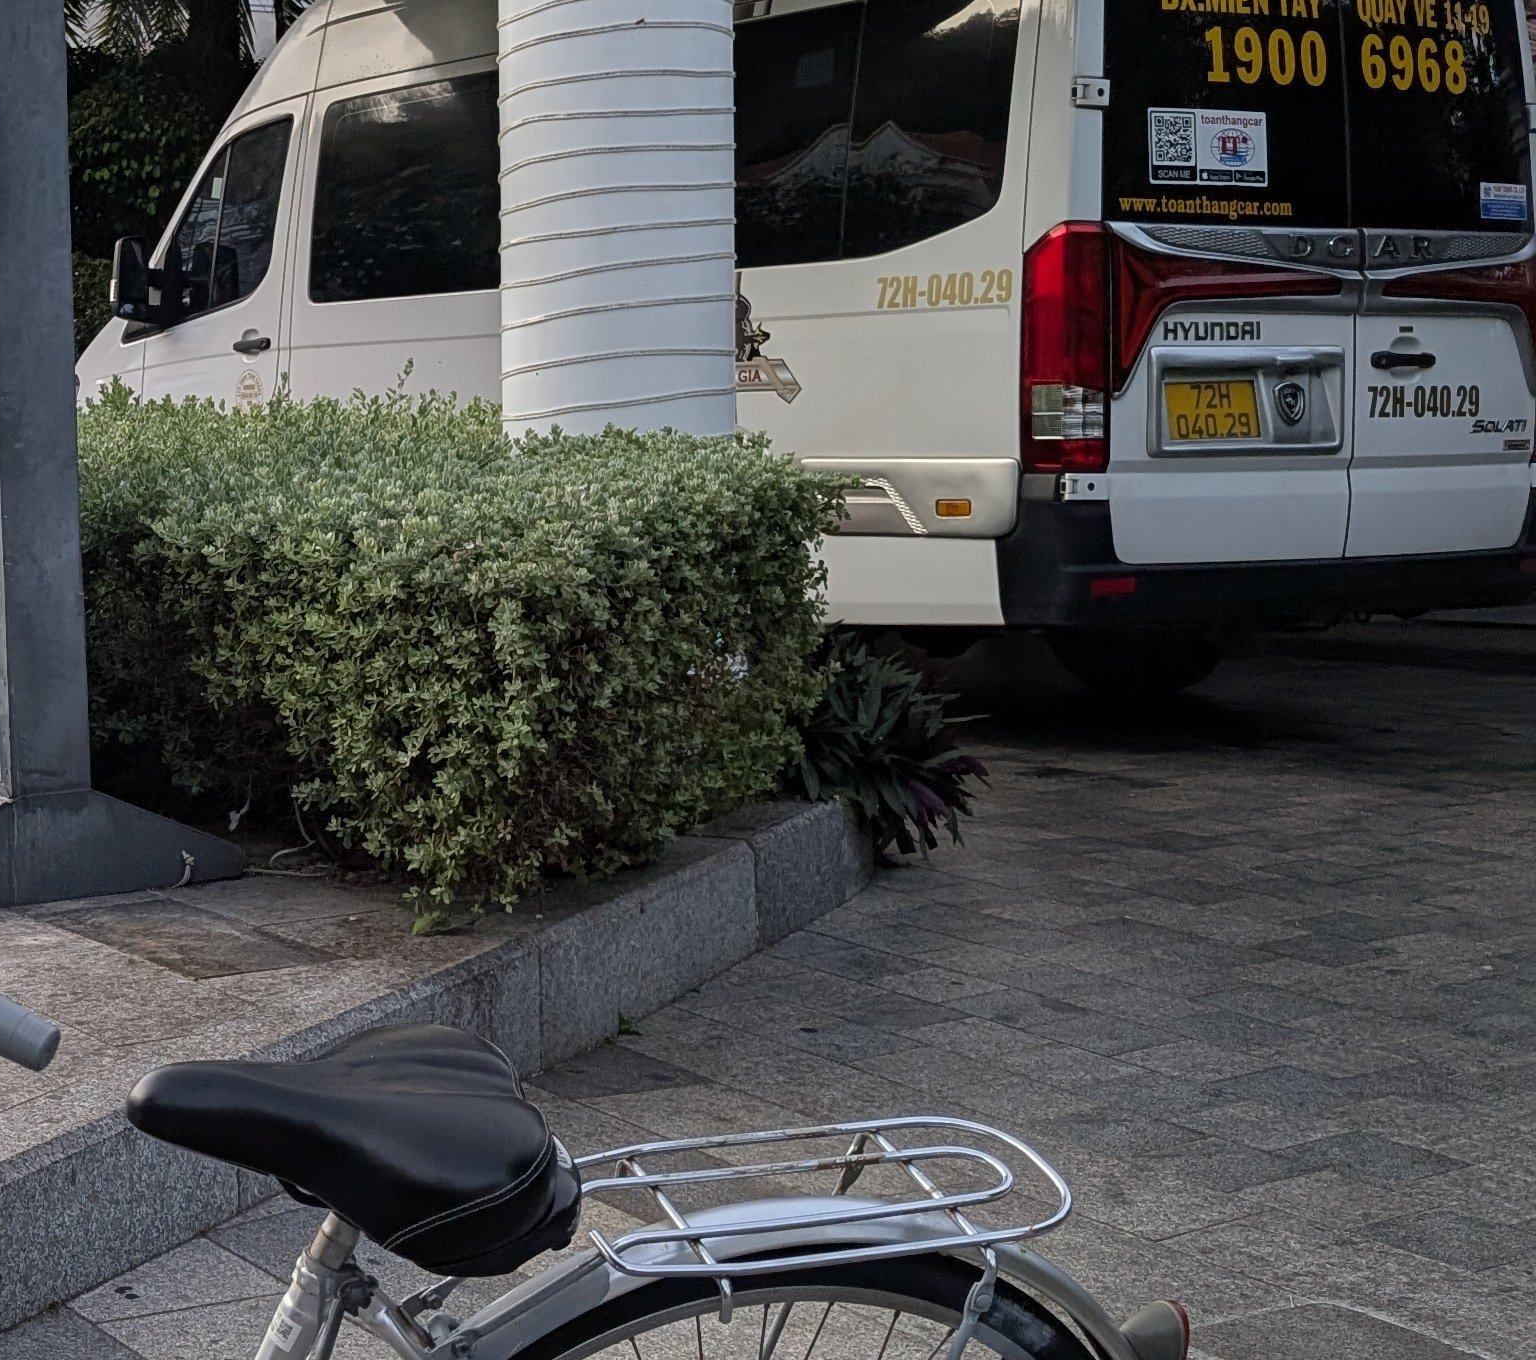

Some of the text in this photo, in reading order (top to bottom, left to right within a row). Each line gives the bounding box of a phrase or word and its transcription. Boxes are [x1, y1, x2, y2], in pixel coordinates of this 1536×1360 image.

[1205, 26, 1467, 94] 1900 6968
[1201, 115, 1263, 128] toanthangcar
[1157, 170, 1178, 179] SCAN
[1119, 195, 1293, 219] www.toanthangcar.com
[876, 268, 1013, 309] 72H-040.29
[1163, 321, 1261, 342] HYUNDAI
[737, 369, 763, 383] GIA
[1189, 384, 1232, 410] 72H
[1367, 384, 1481, 419] 72H-040.29
[1176, 413, 1252, 440] 040.29
[1469, 418, 1528, 434] SOLATI
